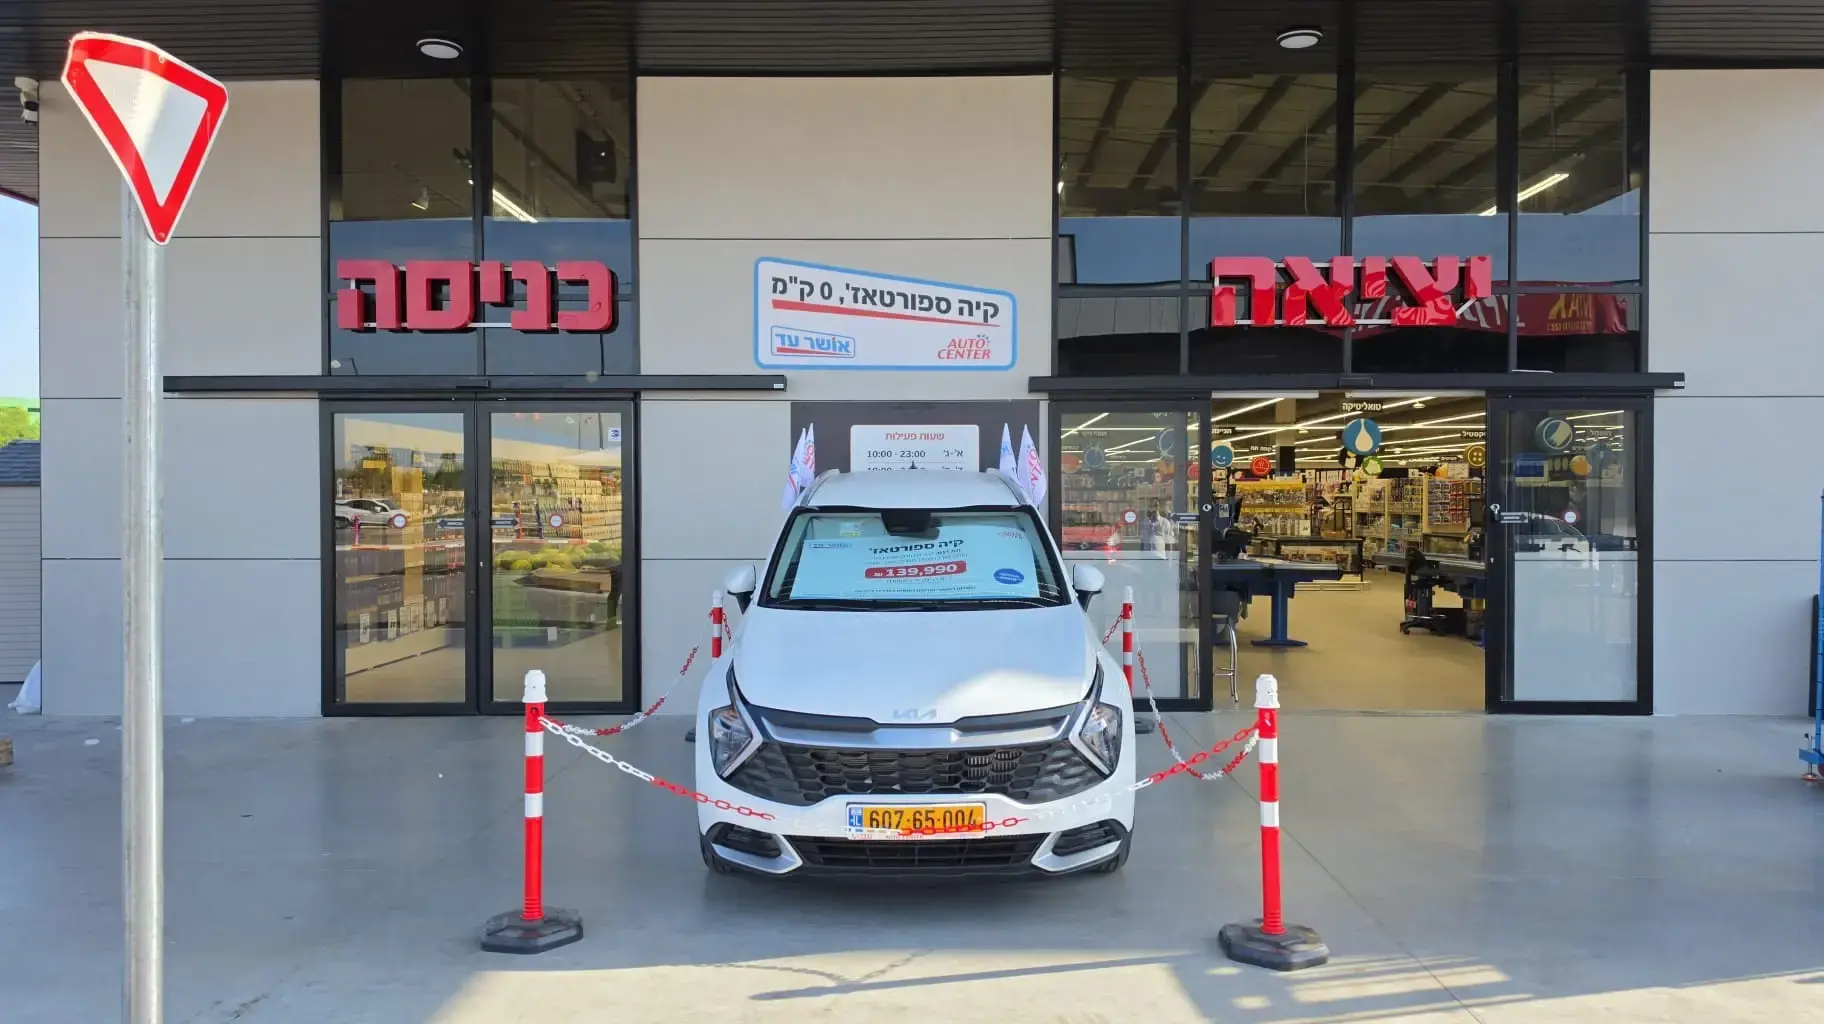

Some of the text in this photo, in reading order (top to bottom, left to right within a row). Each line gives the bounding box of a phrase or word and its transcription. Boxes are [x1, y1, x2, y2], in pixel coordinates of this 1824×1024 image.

[337, 260, 614, 331] כניסה
[771, 275, 814, 302] ק"מ
[820, 281, 833, 300] 0
[1211, 255, 1492, 327] יציאה
[958, 299, 999, 323] קיה
[775, 333, 851, 353] אושר עד
[947, 338, 987, 350] AUTO
[937, 349, 992, 360] CENTER
[885, 431, 945, 441] שעות פעילות
[867, 450, 893, 458] 10:00
[899, 450, 926, 458] 23:00
[869, 543, 935, 555] ספורטאז'
[938, 539, 965, 548] קיה
